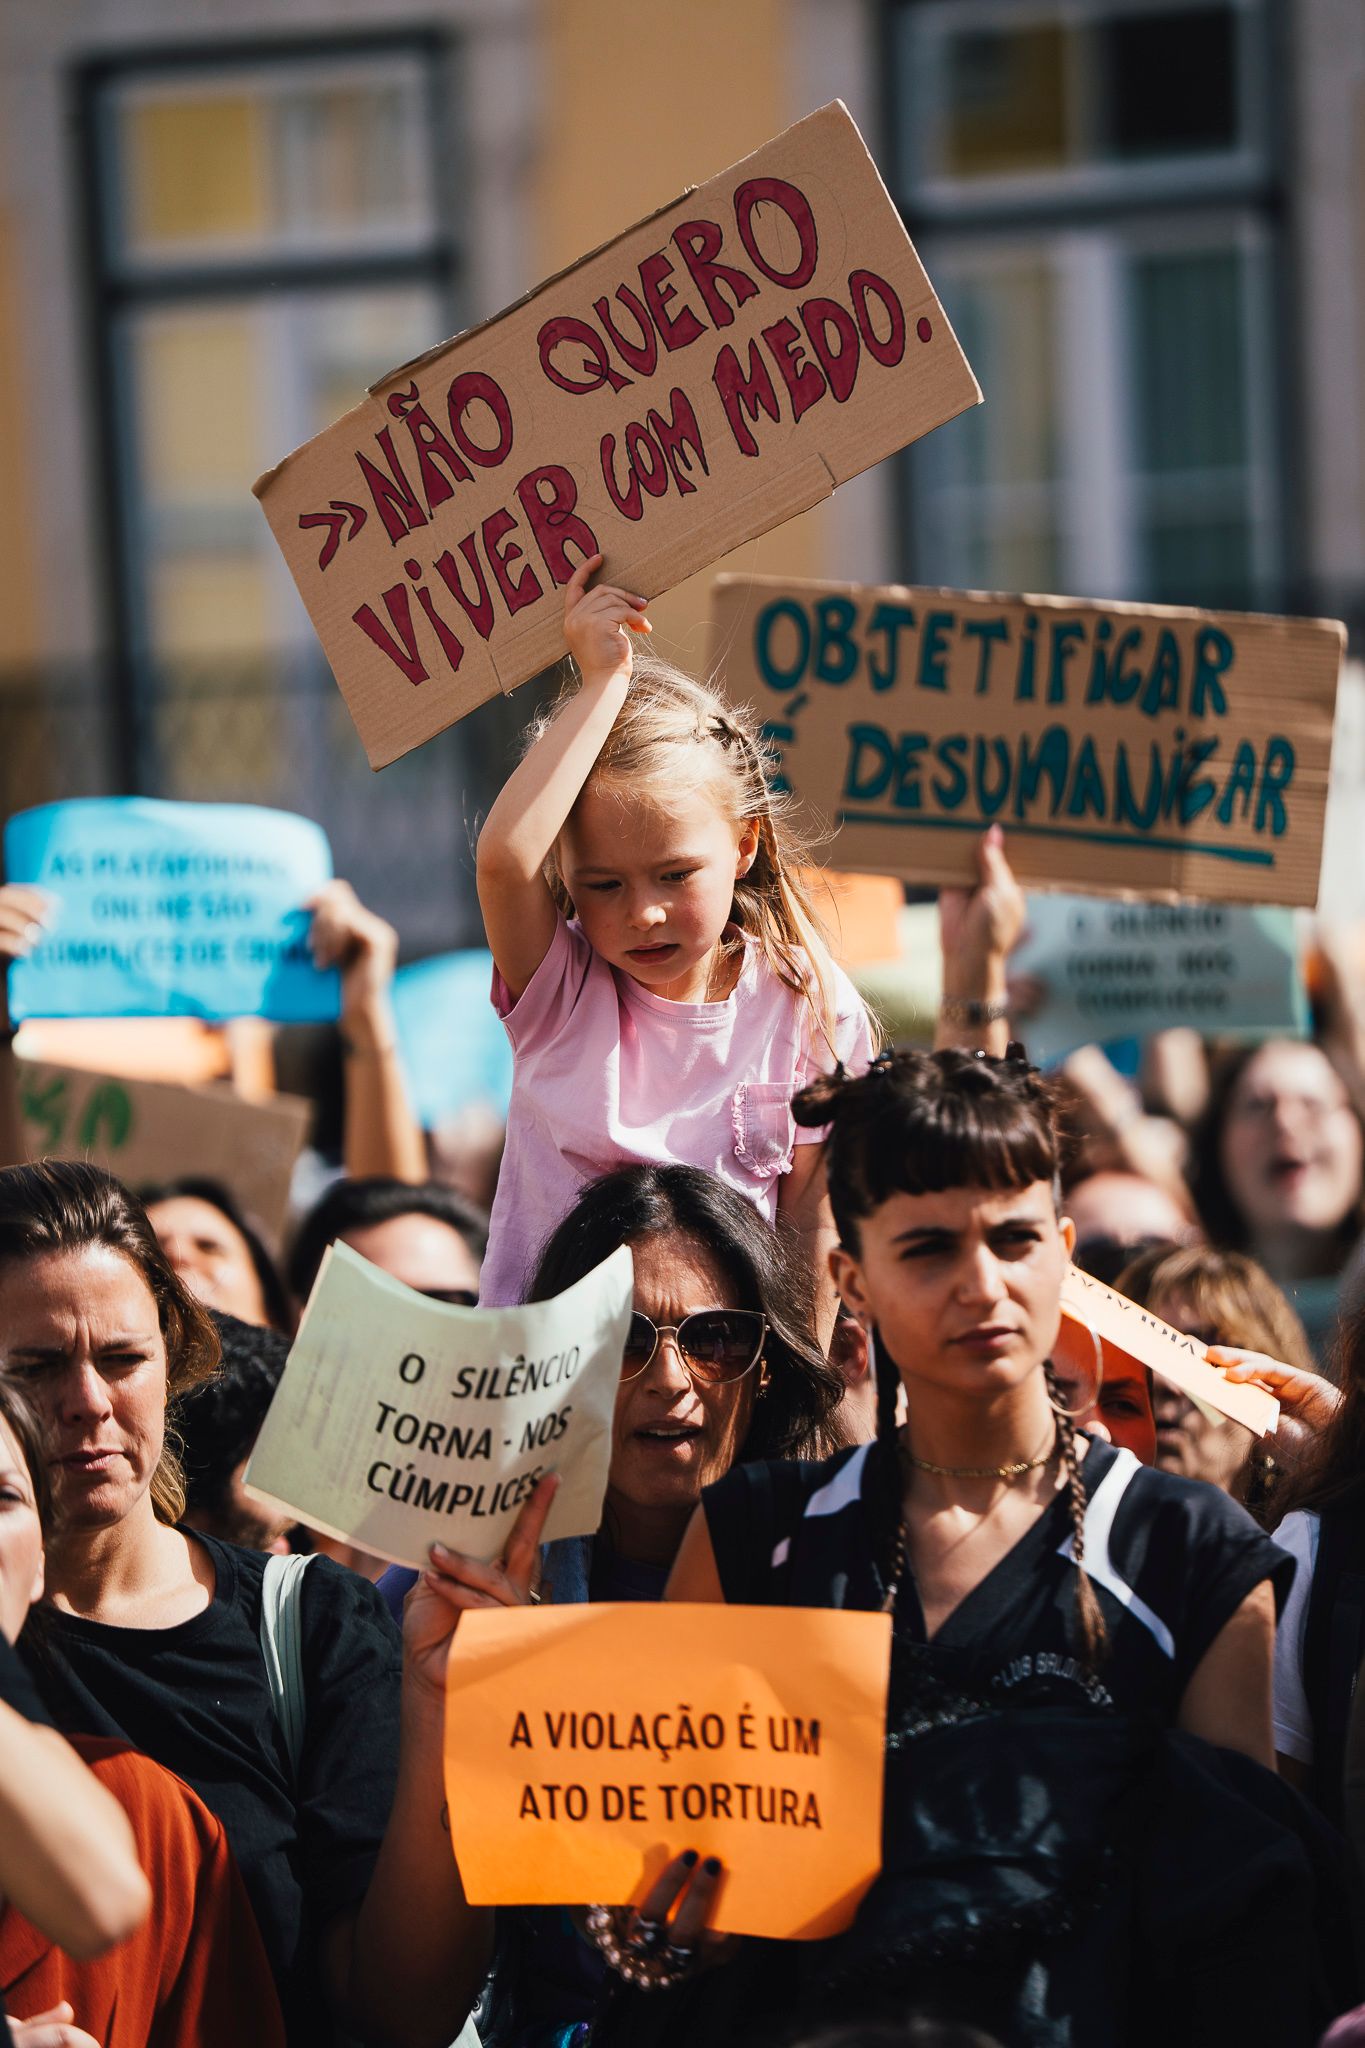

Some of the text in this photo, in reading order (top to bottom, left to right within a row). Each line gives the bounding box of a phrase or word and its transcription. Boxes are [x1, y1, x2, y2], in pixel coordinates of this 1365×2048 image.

[355, 177, 818, 547] NÃO QUERO
[352, 269, 934, 687] VIVER COM MEDO.
[754, 596, 1235, 717] OBJETIFICAR
[843, 721, 1296, 838] DESUMANIZAR
[398, 1345, 580, 1400] O SILÊNCIO
[375, 1400, 493, 1461] TORNA
[519, 1405, 572, 1454] NOS
[366, 1460, 545, 1517] CÚMPLICES
[509, 1703, 822, 1763] A VIOLAÇÃO É UM
[519, 1782, 823, 1830] ATO DE TORTURA
